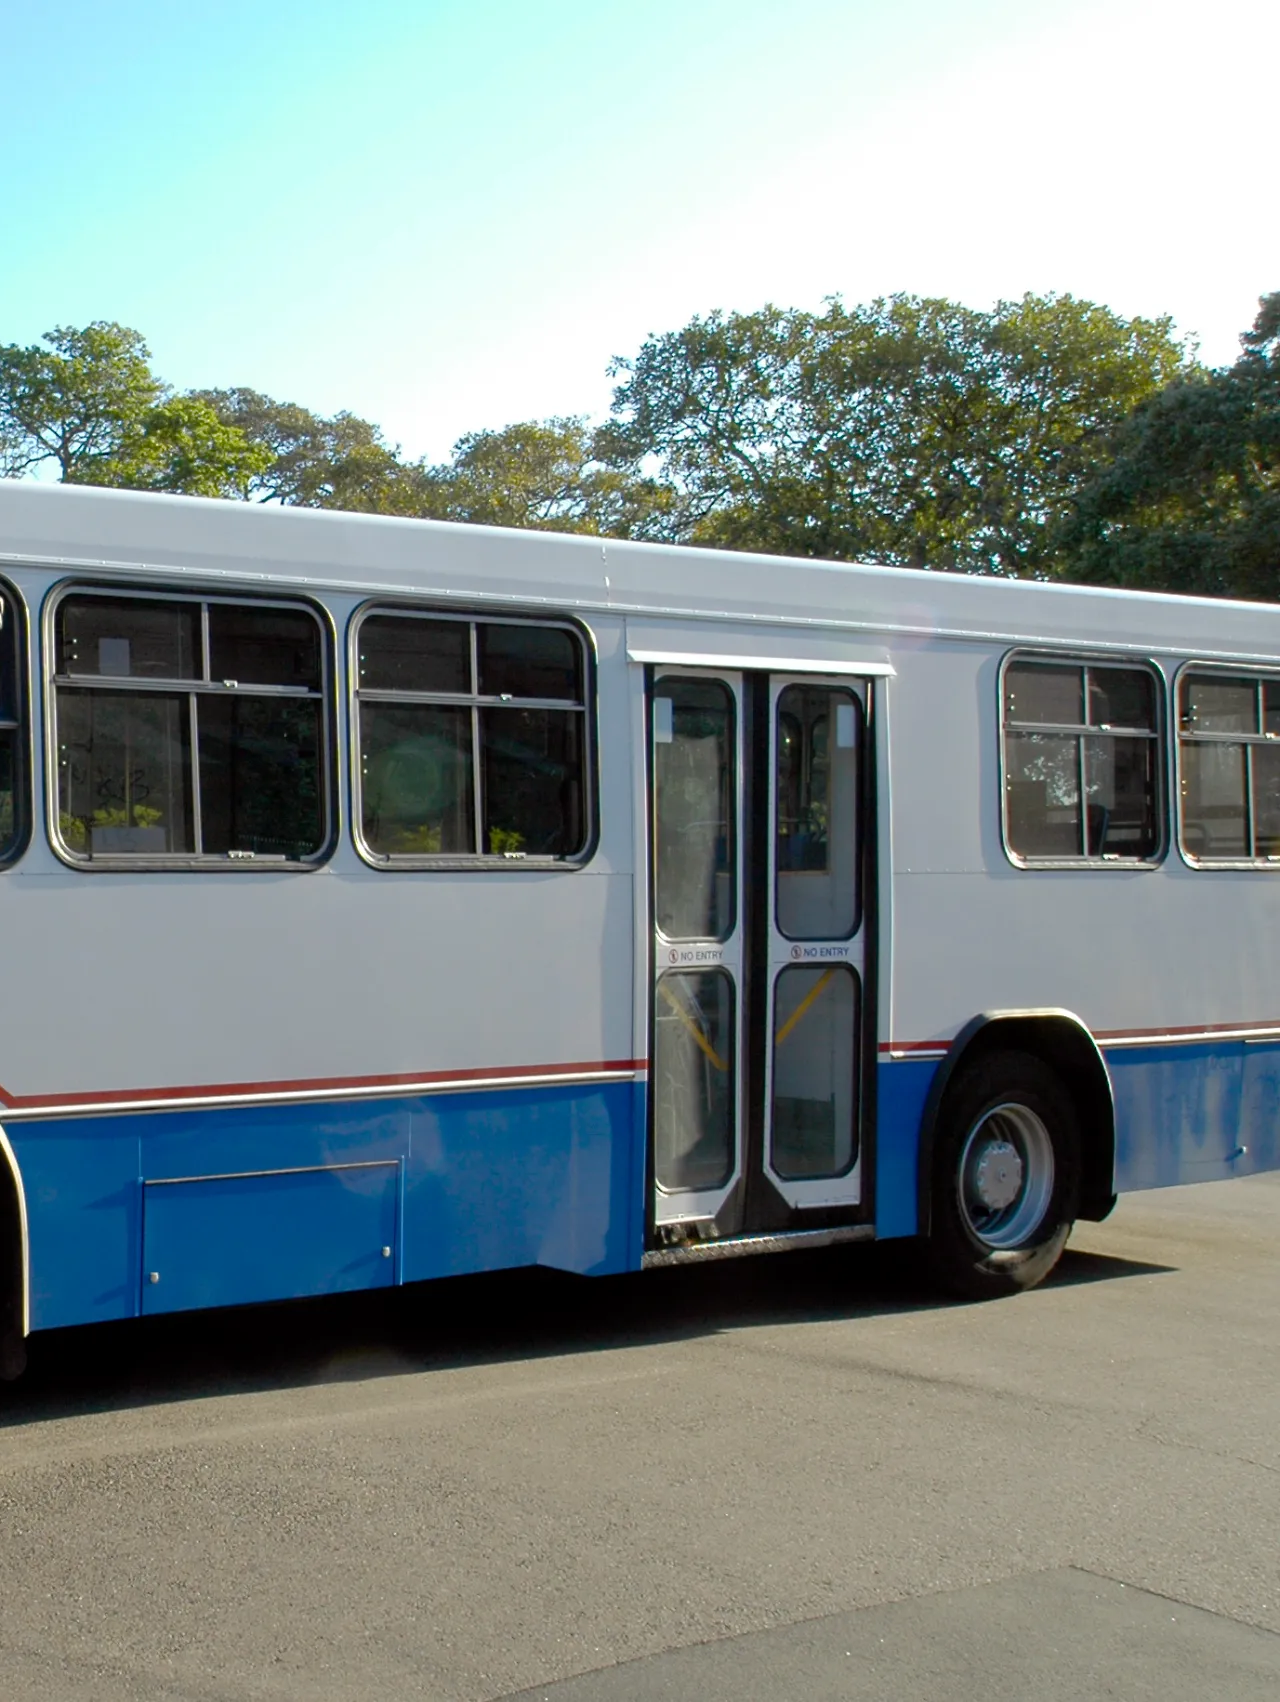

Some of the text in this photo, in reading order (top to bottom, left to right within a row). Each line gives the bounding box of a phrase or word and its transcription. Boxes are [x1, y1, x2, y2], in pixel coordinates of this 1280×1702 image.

[680, 950, 724, 962] NO ENTRY
[803, 946, 850, 958] NO ENTRY
